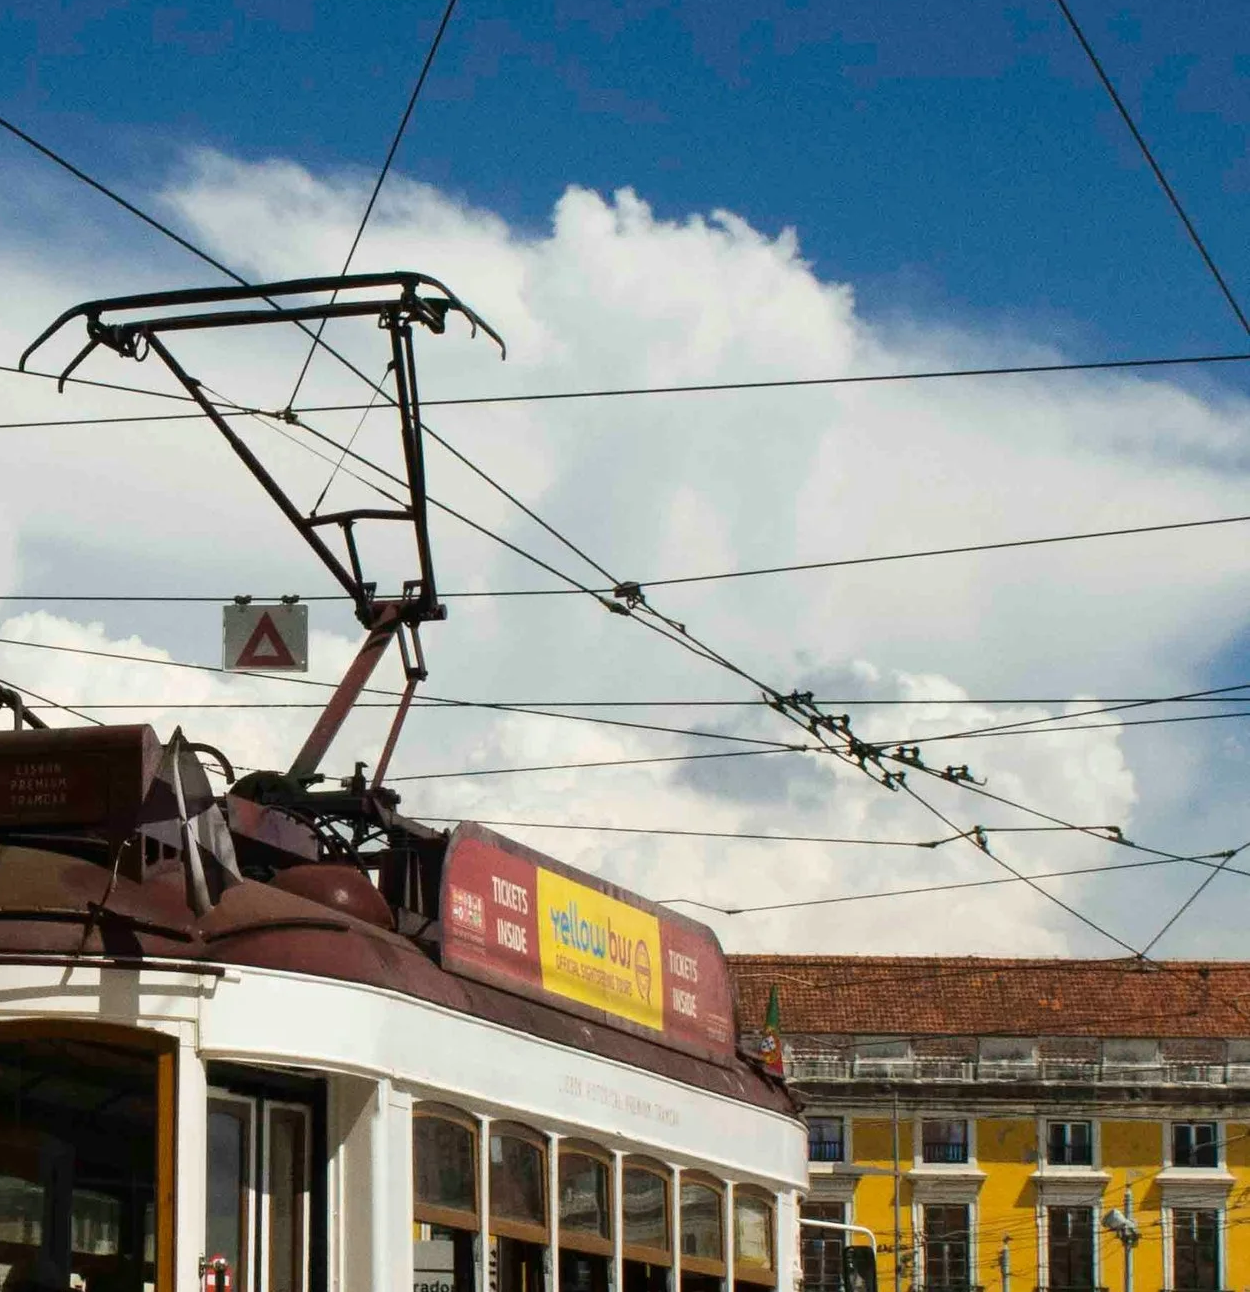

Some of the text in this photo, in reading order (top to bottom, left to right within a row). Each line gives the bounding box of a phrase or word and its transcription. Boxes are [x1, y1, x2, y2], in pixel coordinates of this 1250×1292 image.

[492, 876, 528, 915] TICKETS
[497, 918, 527, 954] INSIDE
[669, 949, 697, 981] TICKETS
